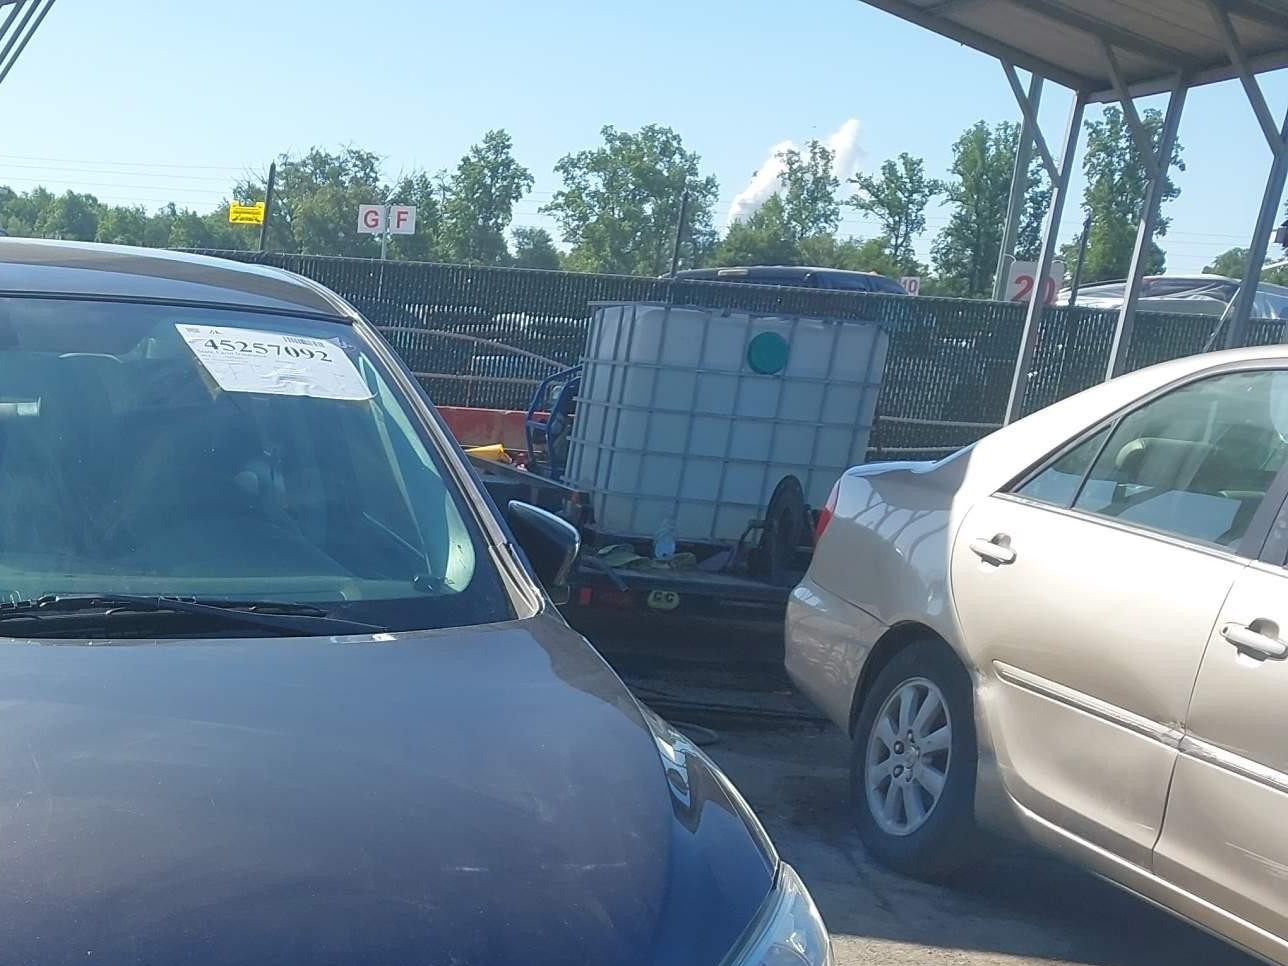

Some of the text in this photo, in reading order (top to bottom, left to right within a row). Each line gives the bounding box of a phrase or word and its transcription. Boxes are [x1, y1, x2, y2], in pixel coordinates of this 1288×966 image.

[363, 210, 380, 228] G
[396, 211, 409, 229] F
[203, 337, 333, 363] 45257092
